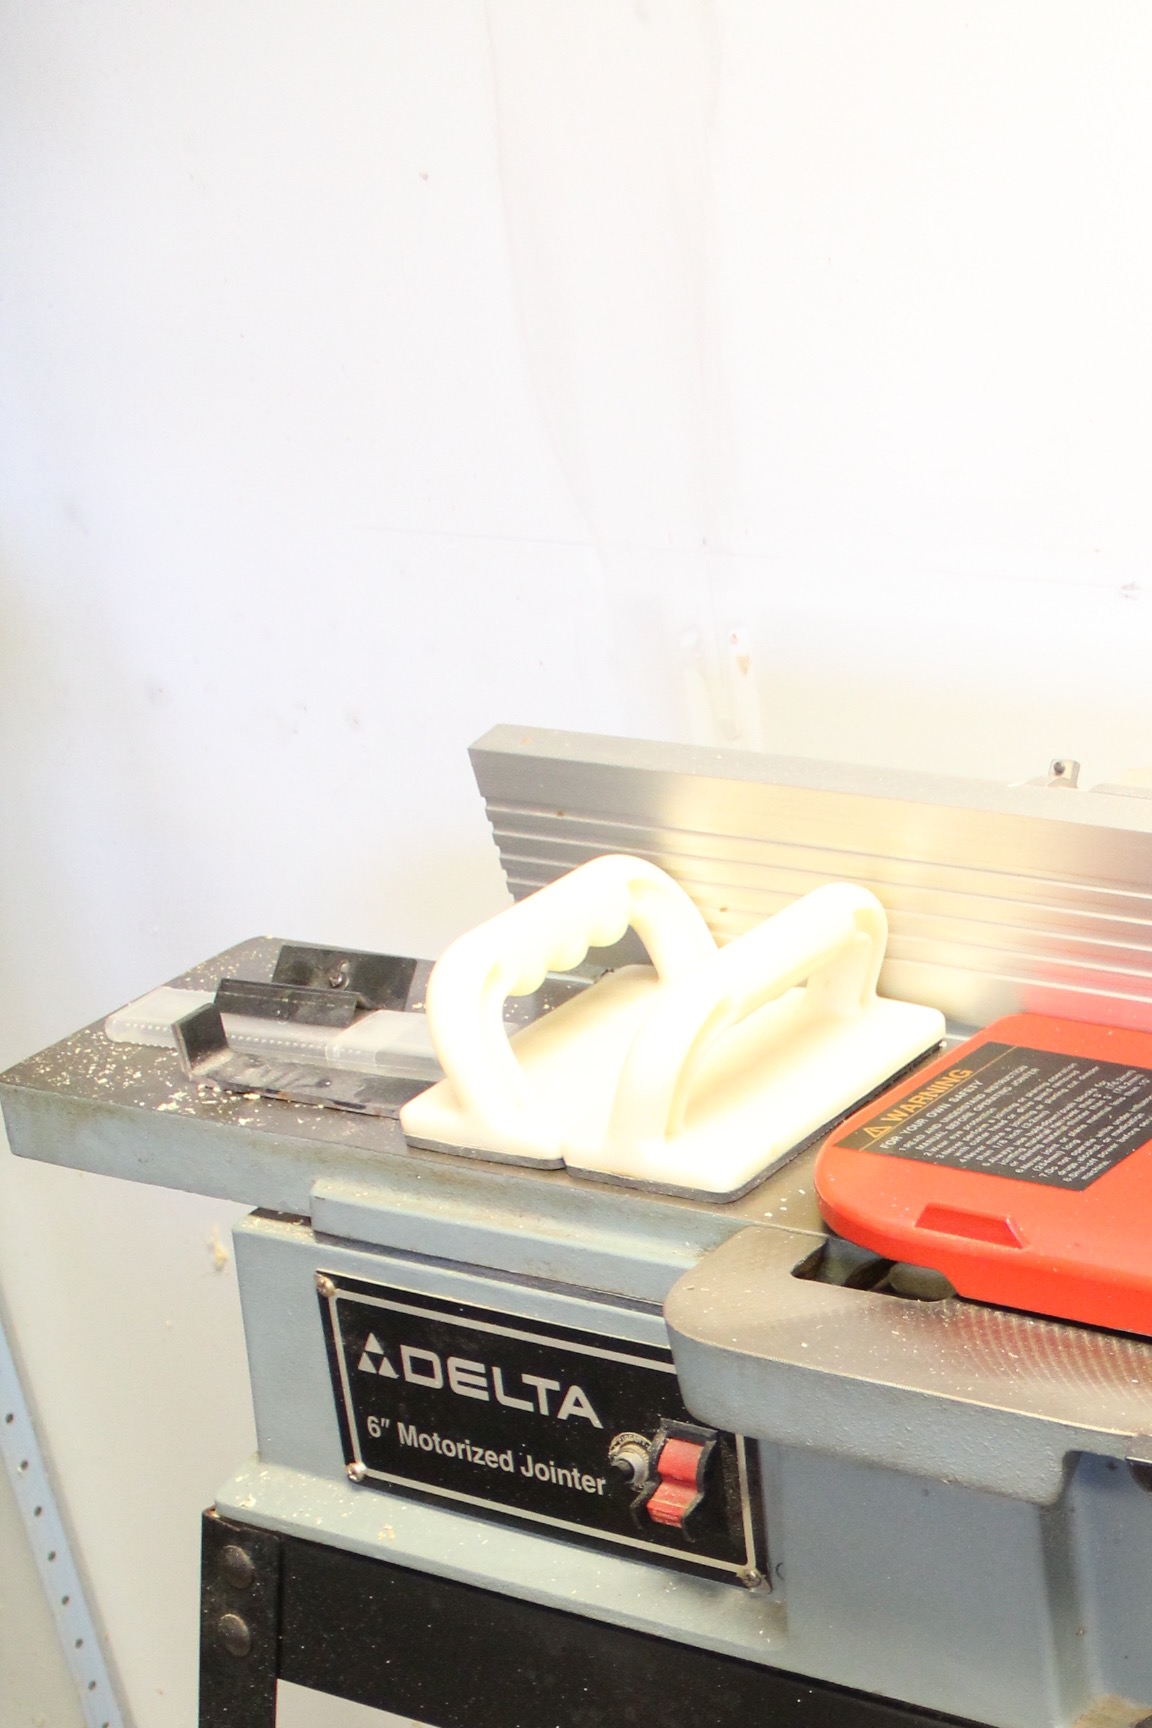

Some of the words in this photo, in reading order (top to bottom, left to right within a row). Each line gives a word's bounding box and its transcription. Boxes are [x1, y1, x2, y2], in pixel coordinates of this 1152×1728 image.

[880, 1069, 973, 1121] WARNING
[880, 1136, 902, 1149] FOR
[900, 1119, 928, 1134] YOUR
[926, 1103, 951, 1117] OWN
[948, 1080, 983, 1102] SAFETY
[915, 1131, 948, 1150] MANUAL
[945, 1112, 975, 1130] BEFORE
[973, 1087, 1012, 1111] OPERATING
[925, 1124, 942, 1134] AND
[940, 1094, 986, 1122] UNDERSTAND
[984, 1065, 1028, 1093] INSTRUCTION
[400, 1344, 603, 1429] DELTA
[366, 1415, 390, 1438] 6"
[397, 1421, 514, 1473] Motorized
[520, 1454, 606, 1496] Jointer
